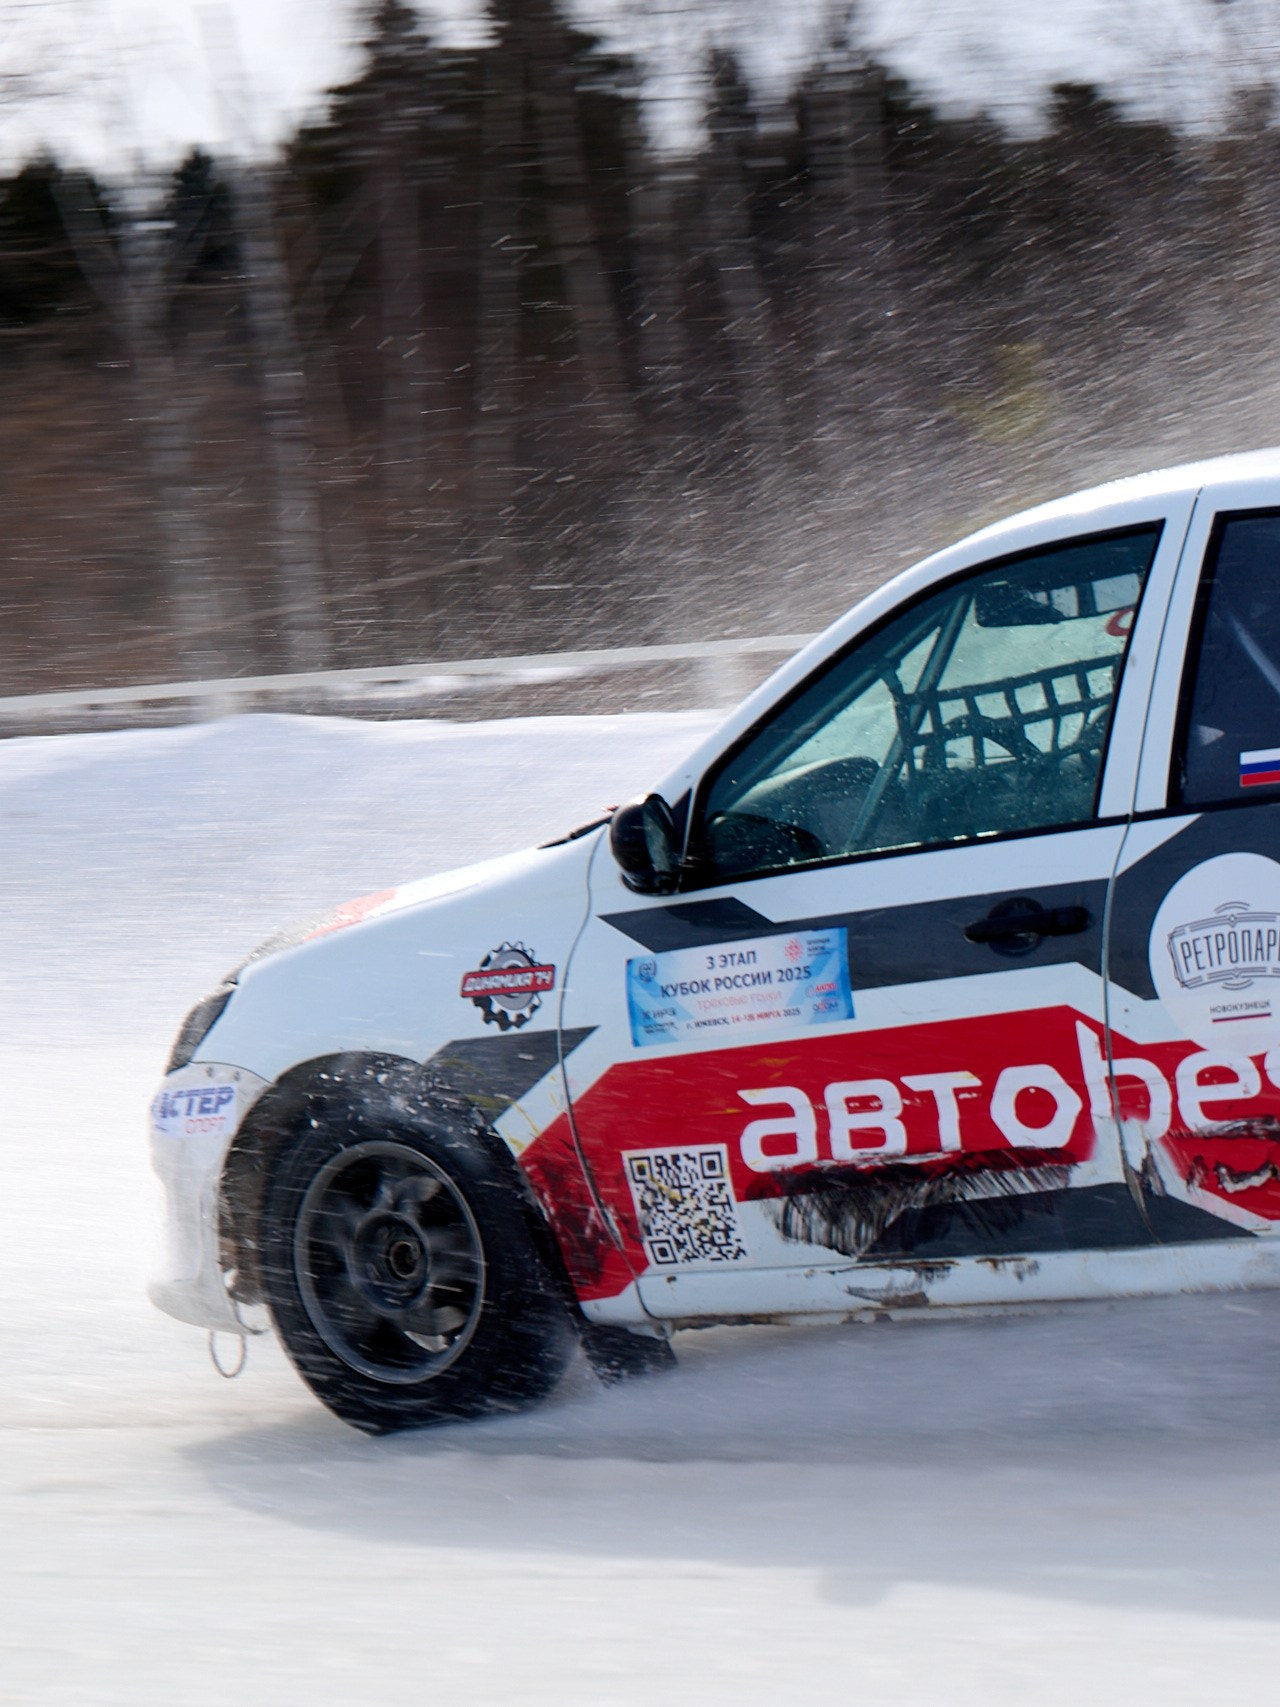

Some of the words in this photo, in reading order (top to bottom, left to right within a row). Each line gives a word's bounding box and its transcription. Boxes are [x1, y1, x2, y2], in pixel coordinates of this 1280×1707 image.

[706, 956, 715, 970] 3
[719, 950, 757, 968] ЭТАП
[660, 977, 711, 998] КУБОК
[715, 970, 772, 991] РОССИИ
[778, 965, 812, 984] 2025
